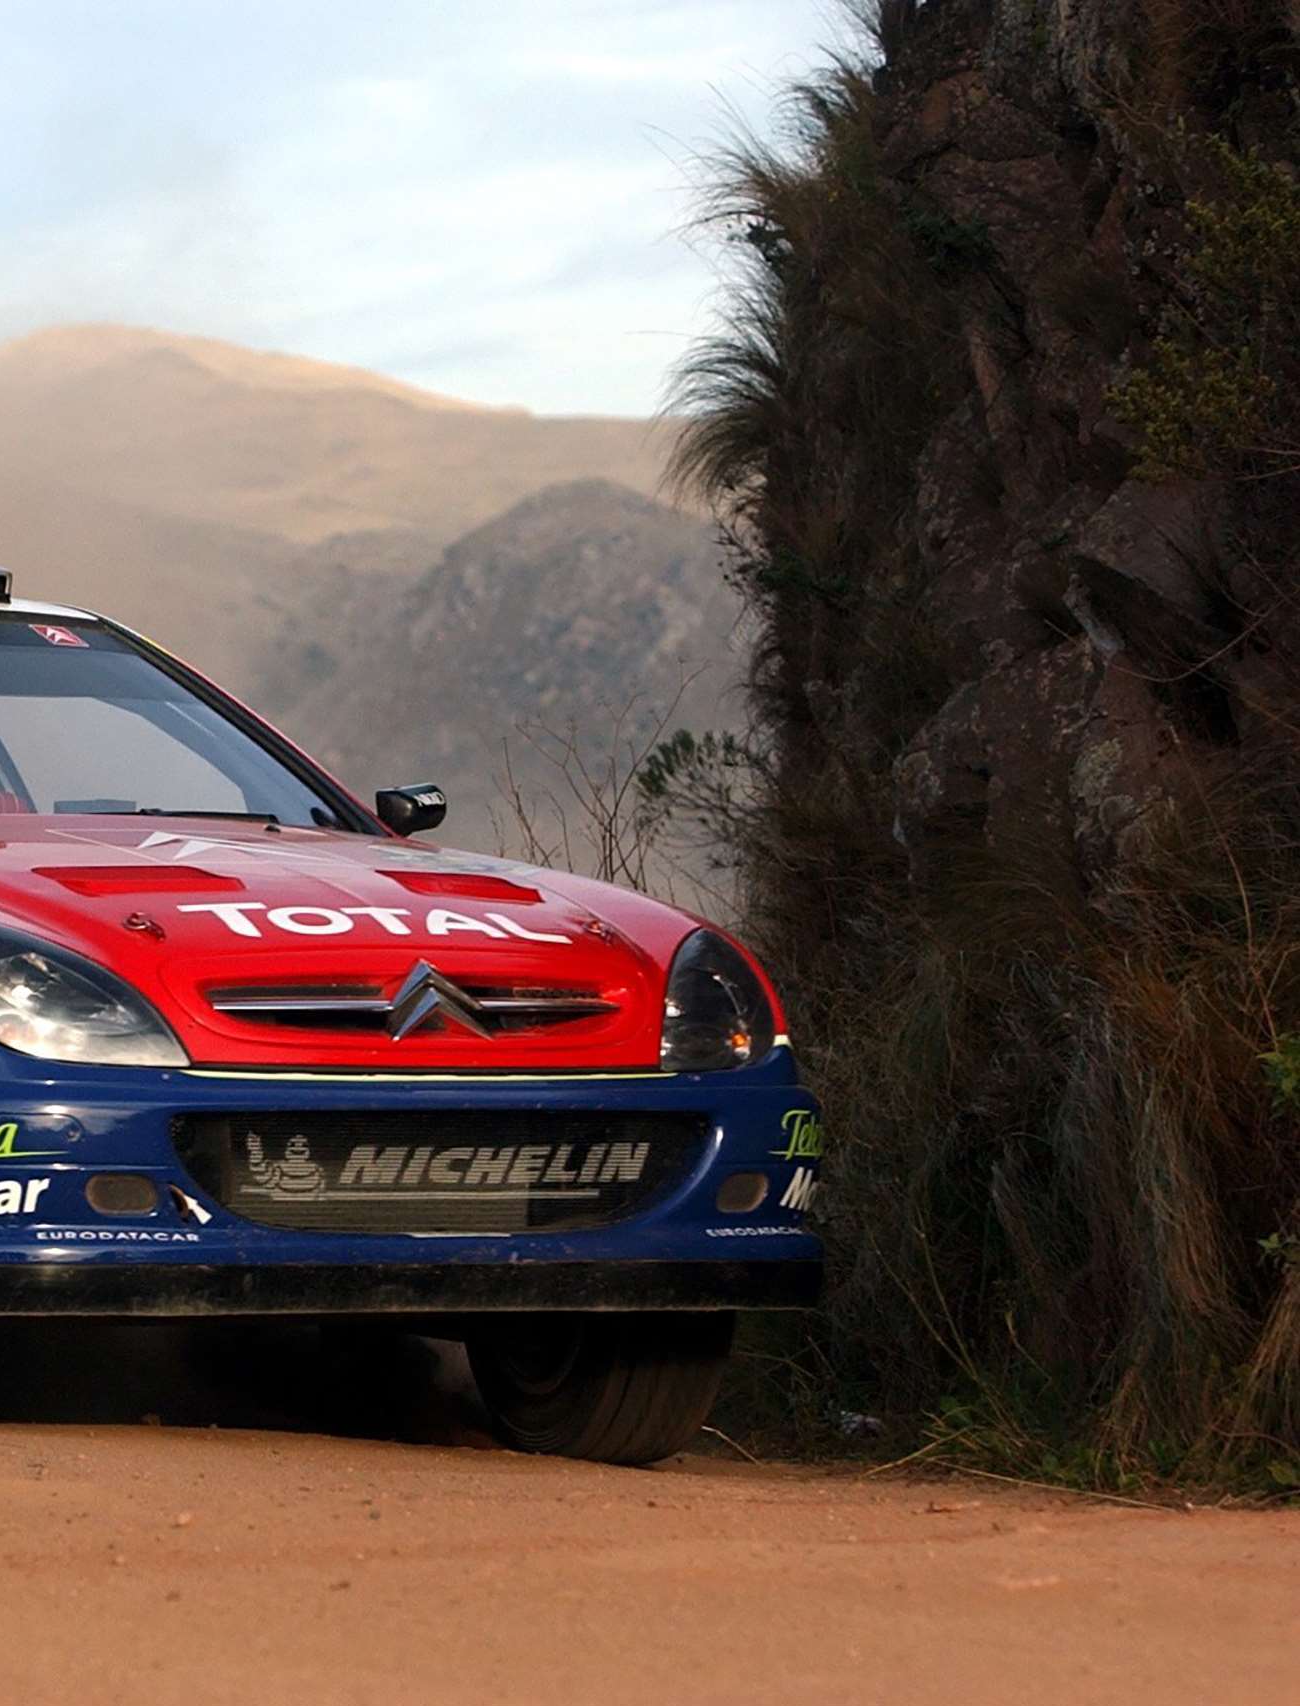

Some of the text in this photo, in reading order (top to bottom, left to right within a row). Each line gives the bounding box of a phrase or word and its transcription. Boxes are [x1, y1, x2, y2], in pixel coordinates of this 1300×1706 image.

[176, 901, 574, 945] TOTAL
[338, 1142, 651, 1185] MICHELIN
[36, 1230, 201, 1243] EURODATACAR
